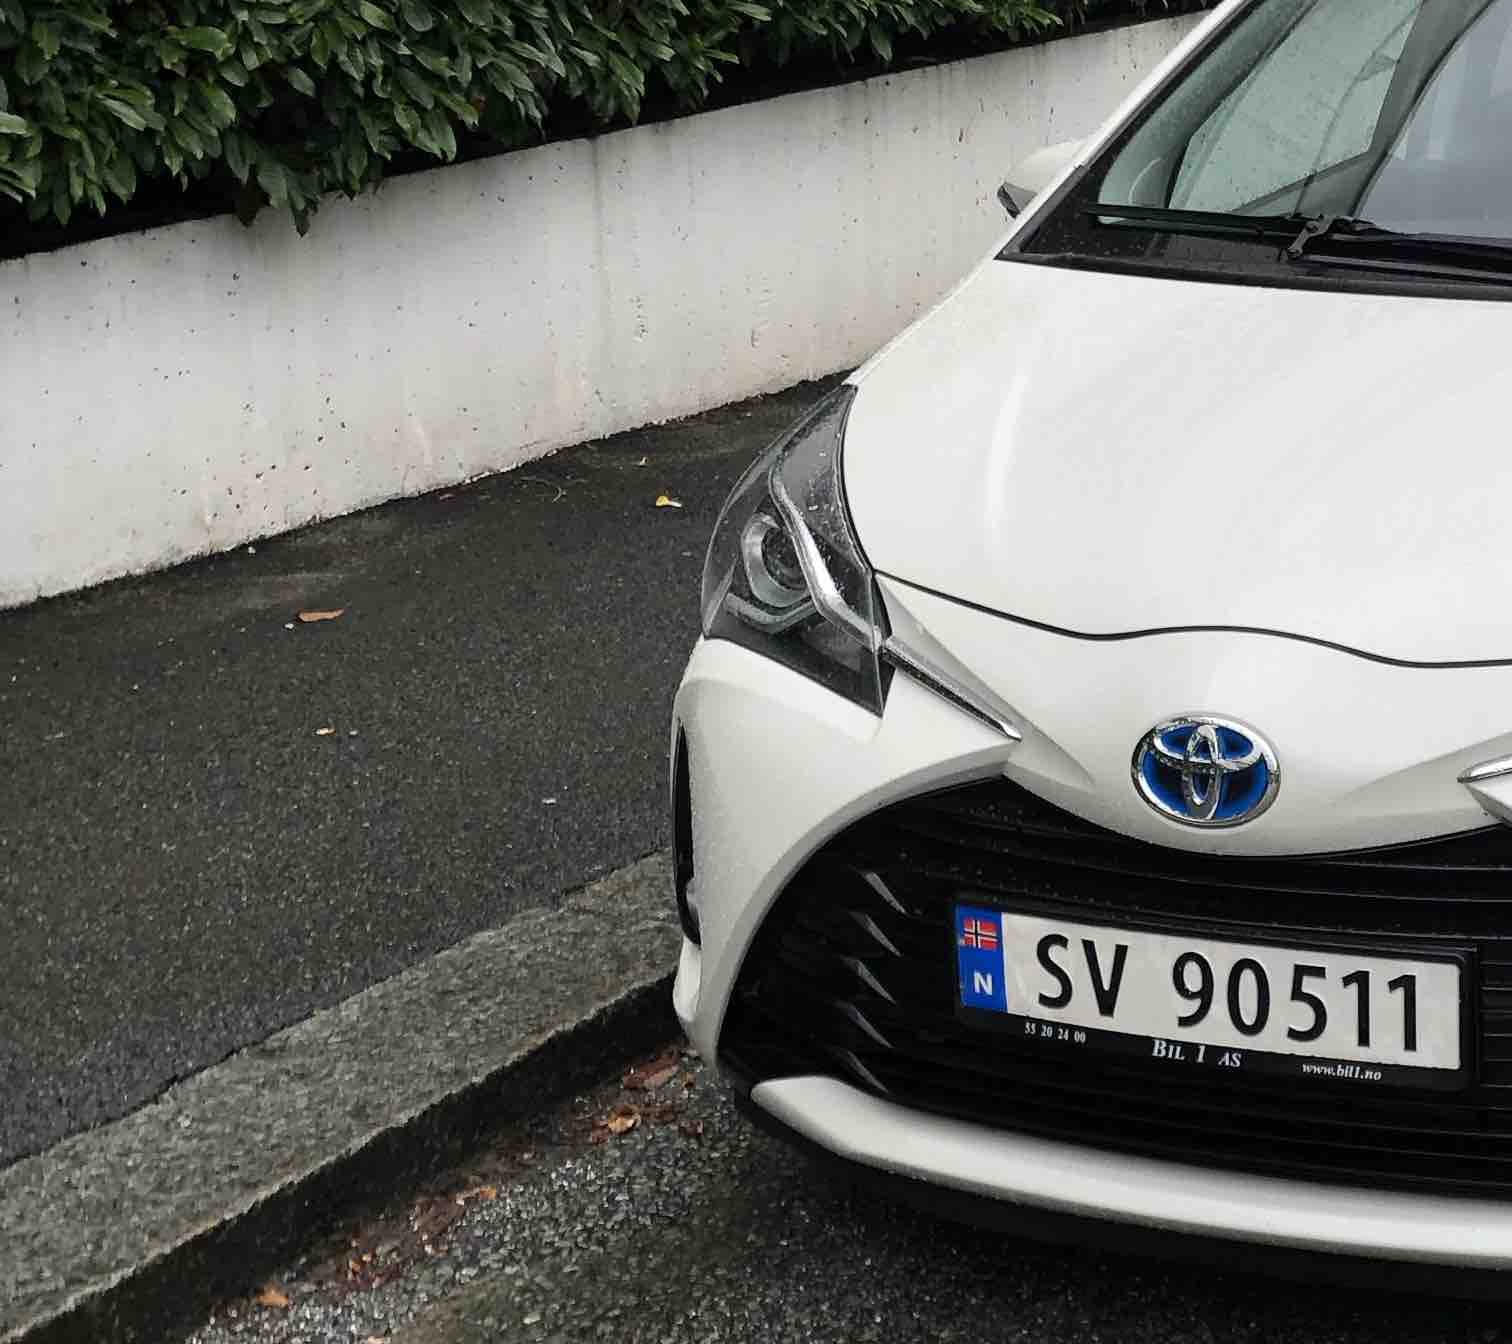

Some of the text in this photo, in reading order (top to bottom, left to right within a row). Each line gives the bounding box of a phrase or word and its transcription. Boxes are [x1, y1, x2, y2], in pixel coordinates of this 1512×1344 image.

[974, 971, 993, 996] N
[1035, 932, 1418, 1053] SV 90511
[1041, 1025, 1052, 1037] 20
[1057, 1028, 1069, 1041] 24
[1074, 1031, 1086, 1043] 00
[1195, 1044, 1206, 1063] 1
[1218, 1052, 1242, 1068] AS
